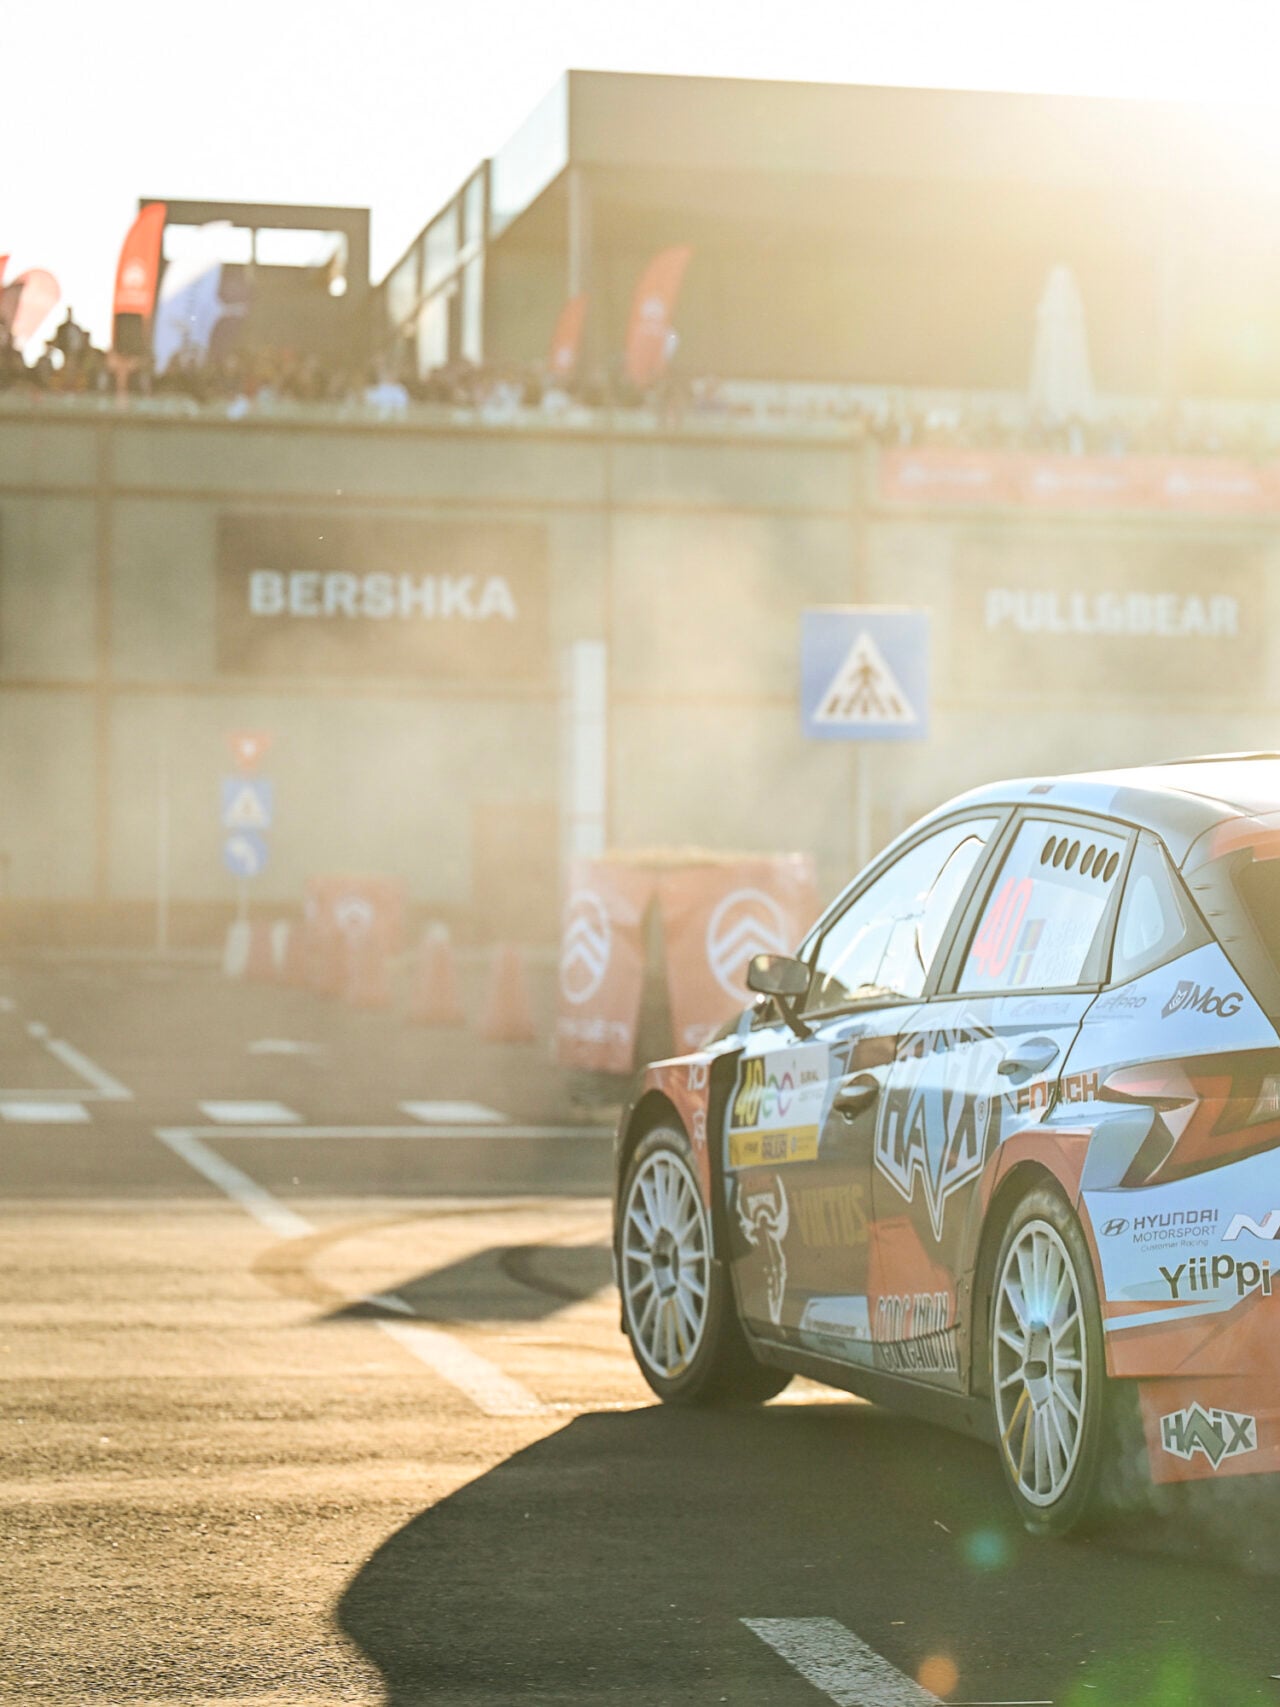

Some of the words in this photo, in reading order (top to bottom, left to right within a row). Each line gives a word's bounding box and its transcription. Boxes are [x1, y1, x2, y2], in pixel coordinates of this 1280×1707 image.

[247, 570, 517, 621] BERSHKA
[985, 589, 1240, 638] PULL&BEAR
[973, 877, 1033, 978] 40
[1133, 1209, 1219, 1230] HYUNDAI
[1133, 1225, 1217, 1244] MOTORSPORT
[1181, 1238, 1209, 1251] Racing
[1158, 1254, 1272, 1299] Yiippi
